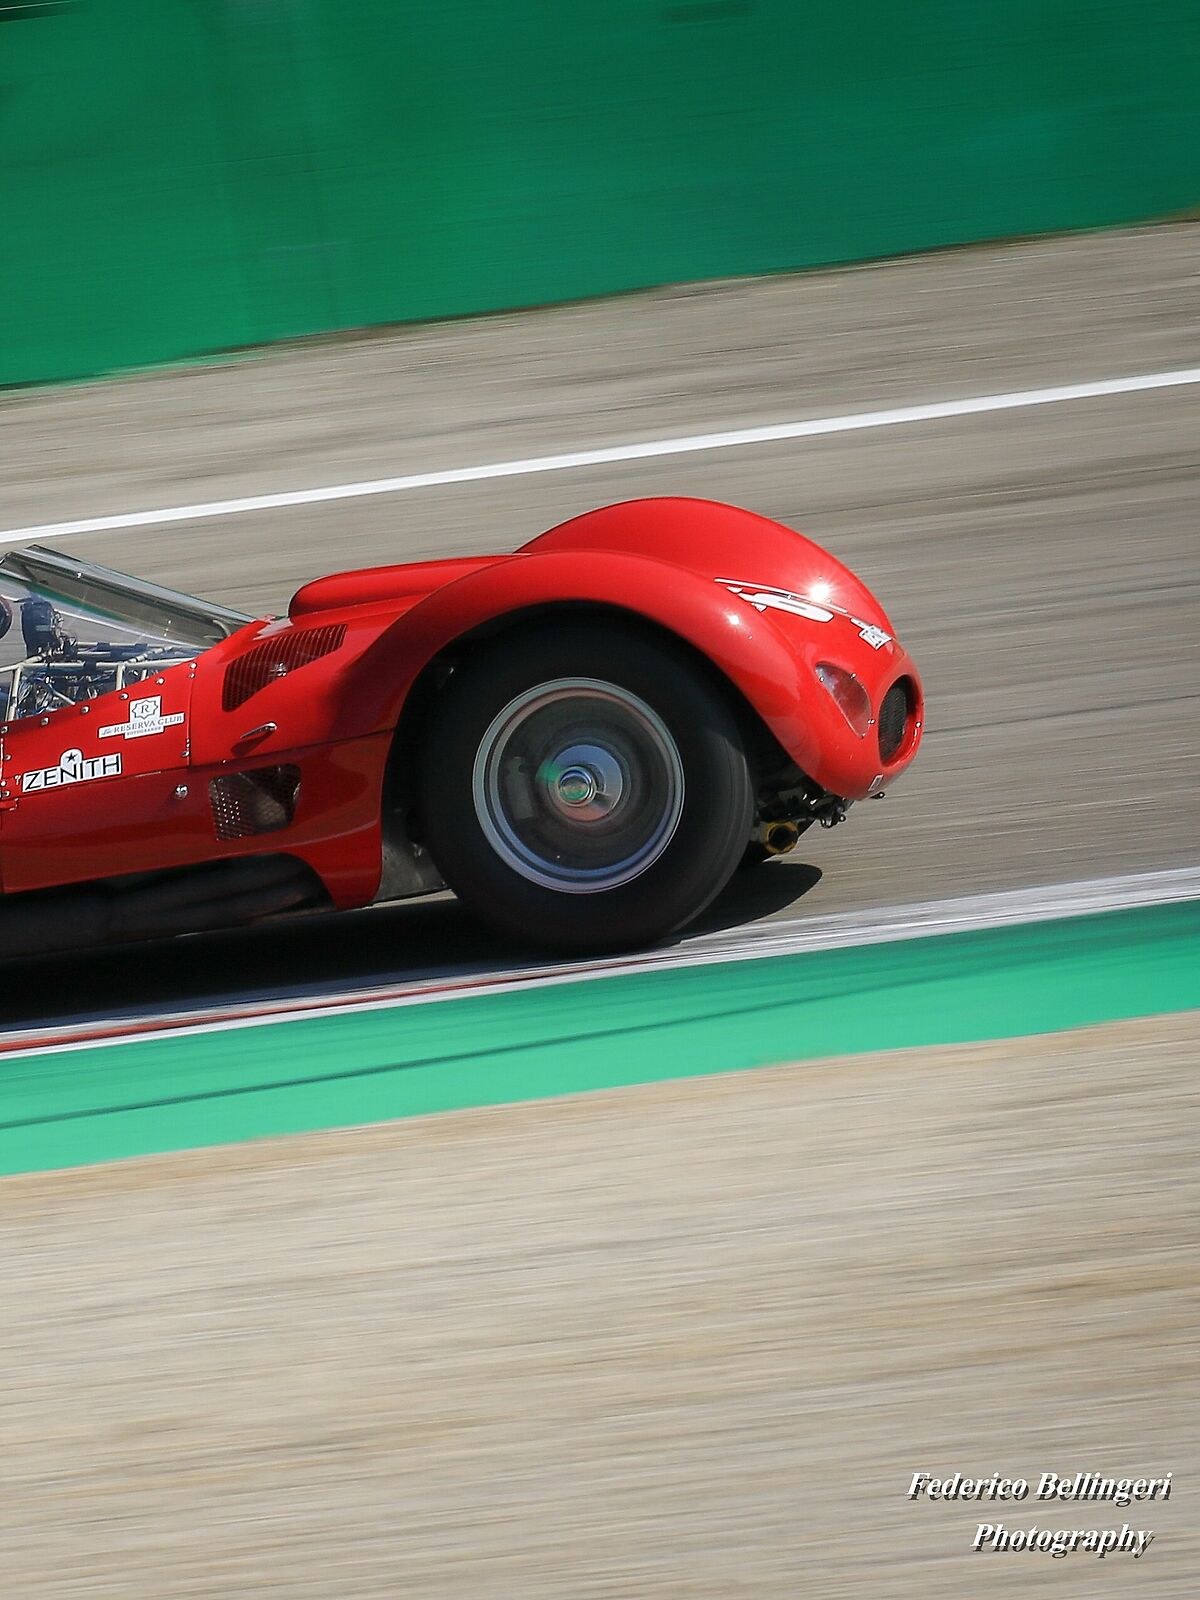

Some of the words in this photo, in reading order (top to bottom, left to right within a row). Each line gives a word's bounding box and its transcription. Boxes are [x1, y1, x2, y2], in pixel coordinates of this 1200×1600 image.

[140, 704, 150, 714] R
[113, 720, 156, 734] RESERVA
[157, 715, 183, 726] CLUB
[24, 755, 121, 791] ZENITH
